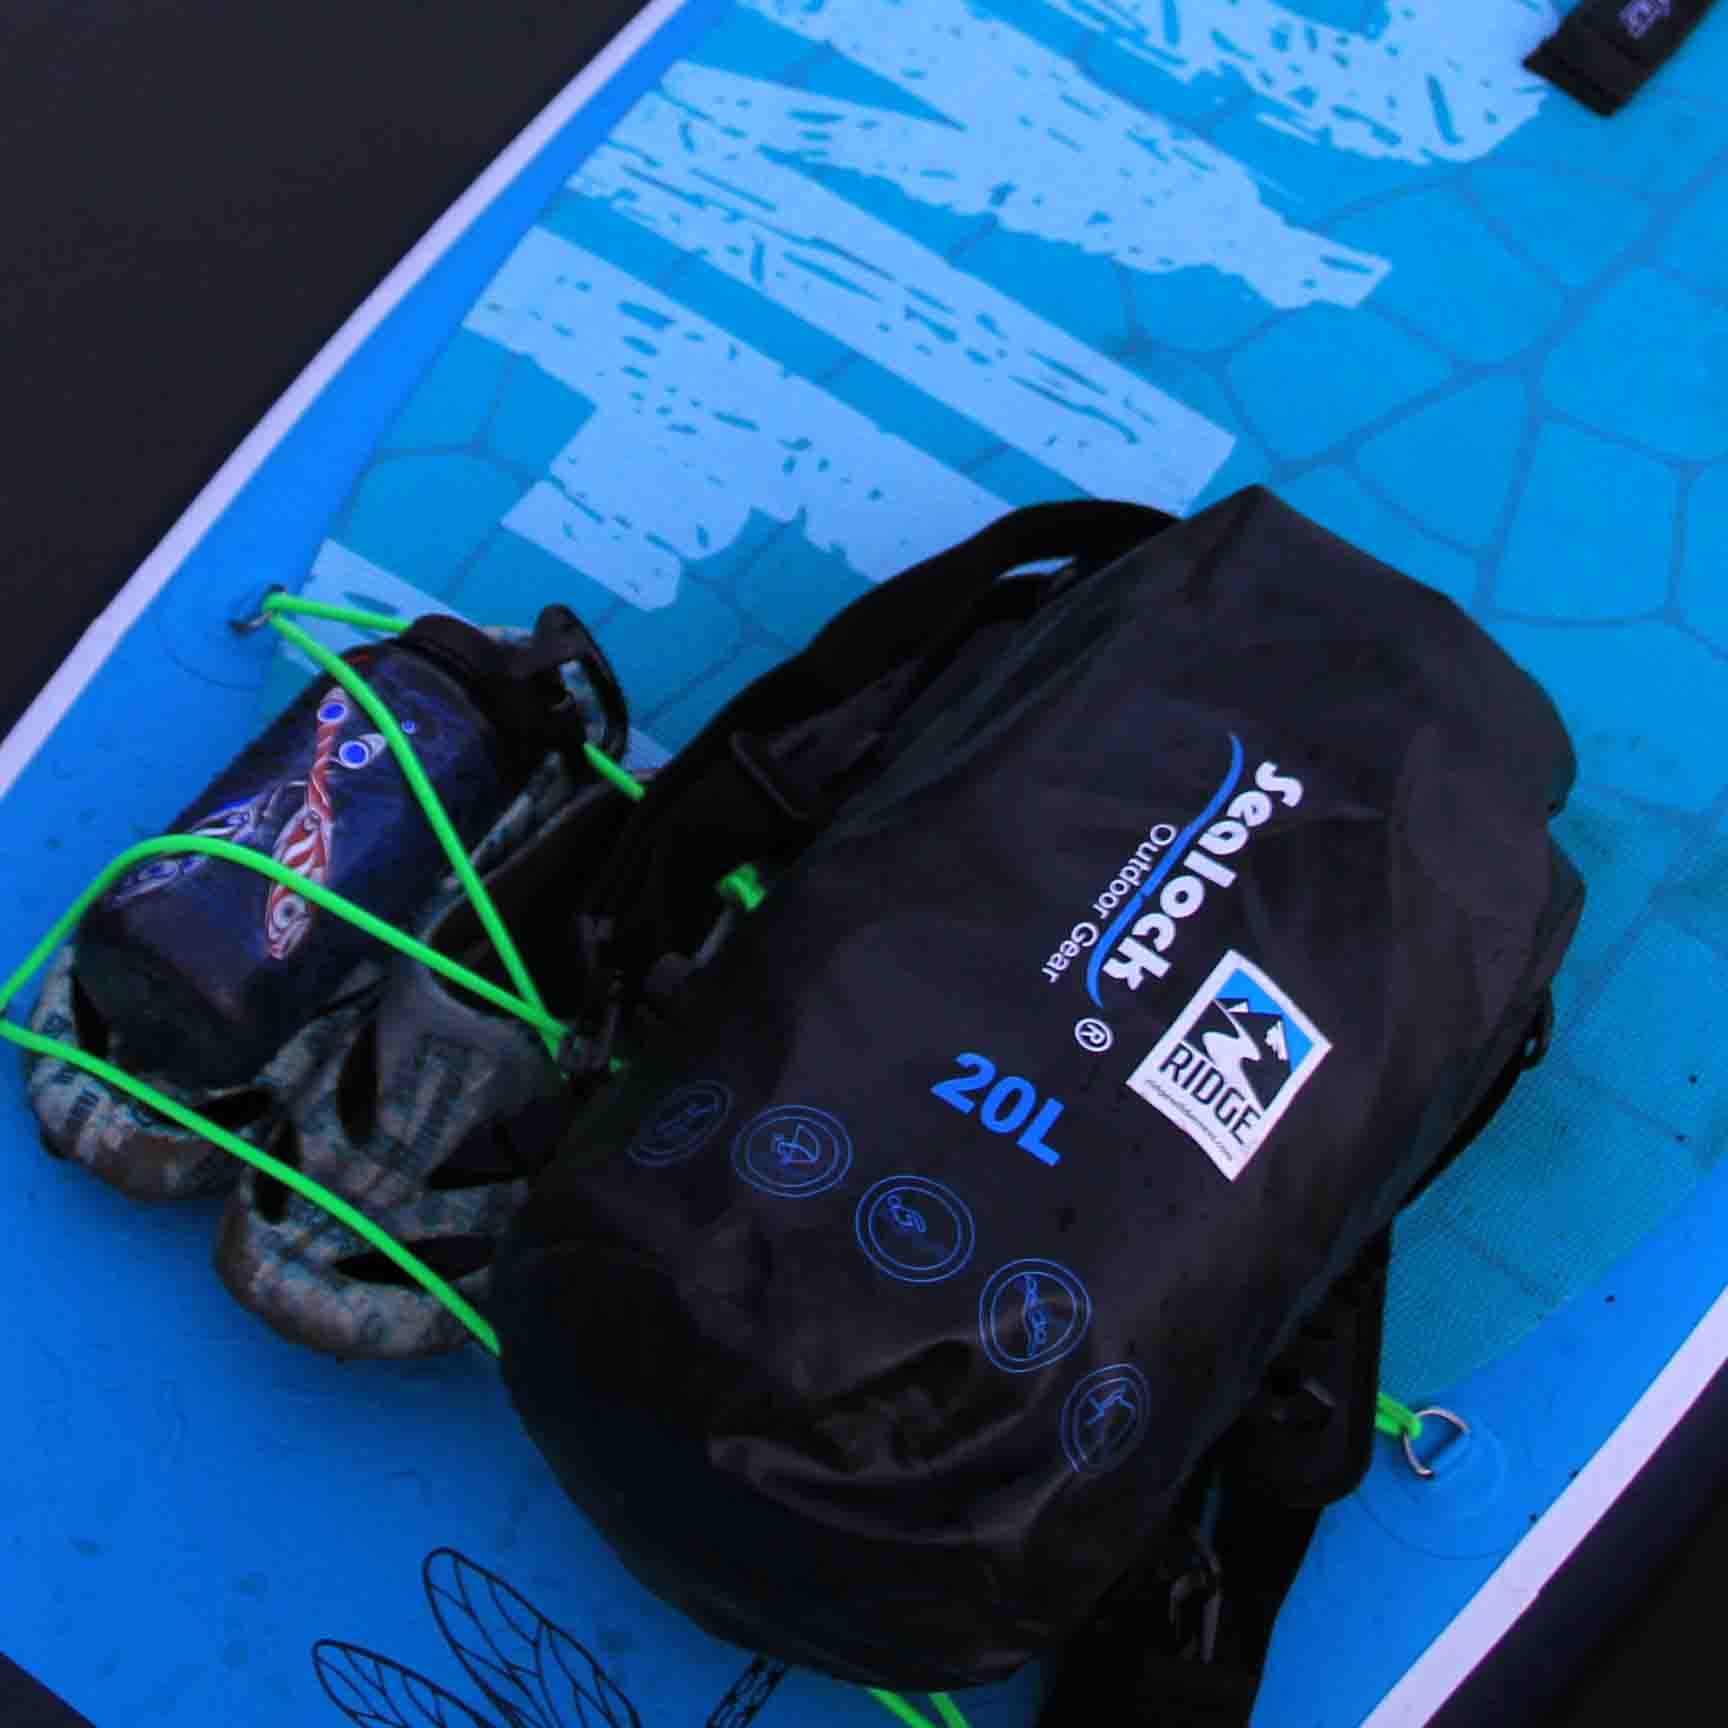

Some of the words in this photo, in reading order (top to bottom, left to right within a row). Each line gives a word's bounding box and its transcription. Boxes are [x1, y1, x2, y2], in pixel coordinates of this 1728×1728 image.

[1090, 822, 1180, 918] Outdoor
[1102, 760, 1304, 991] Sealock
[1040, 919, 1098, 984] Gear
[929, 1052, 1067, 1167] 20L
[1157, 1042, 1262, 1146] RIDGE
